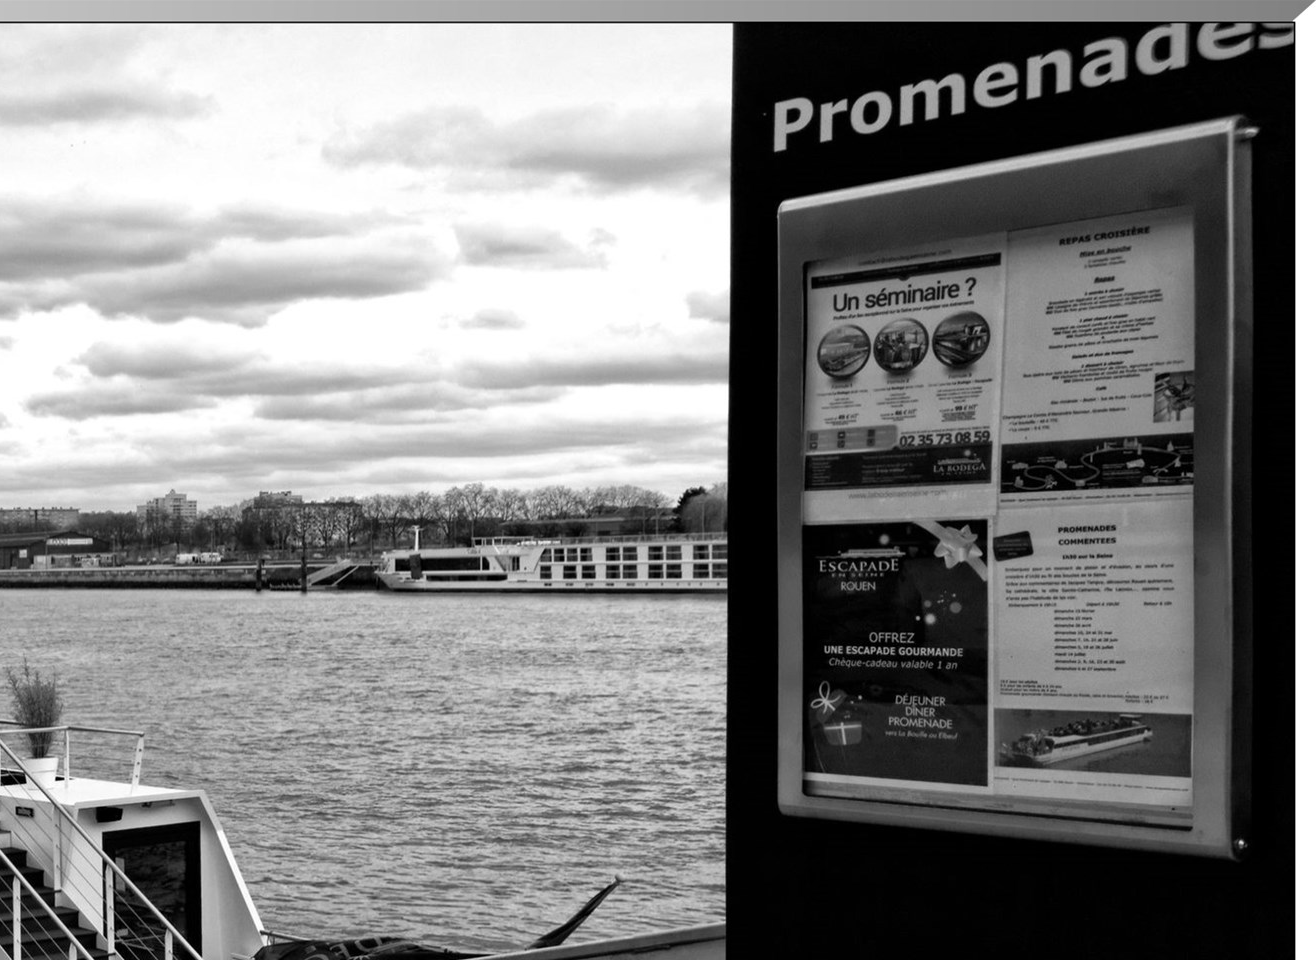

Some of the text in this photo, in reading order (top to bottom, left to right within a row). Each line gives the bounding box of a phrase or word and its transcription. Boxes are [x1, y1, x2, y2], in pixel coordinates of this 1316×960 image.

[1059, 226, 1150, 246] REPAS CROISIÈRE
[833, 277, 977, 312] Un séminaire ?
[899, 435, 915, 448] 02
[917, 434, 933, 446] 35
[936, 432, 952, 445] 73
[955, 431, 972, 444] 08
[974, 430, 990, 442] 59
[933, 462, 986, 473] LA BODEGA
[1058, 524, 1116, 533] PROMENADES
[1058, 537, 1116, 546] COMMENTEES
[819, 558, 899, 572] ESCAPADE
[841, 581, 876, 591] ROUEN
[869, 632, 915, 644] OFFREZ
[824, 645, 963, 657] UNE ESCAPADE GOURMANDE
[829, 657, 898, 670] Chèque-cadeau
[901, 661, 934, 670] valable
[937, 661, 942, 670] 1
[895, 694, 946, 706] DÉJEUNER
[905, 706, 935, 718] DÎNER
[888, 716, 953, 729] PROMENADE
